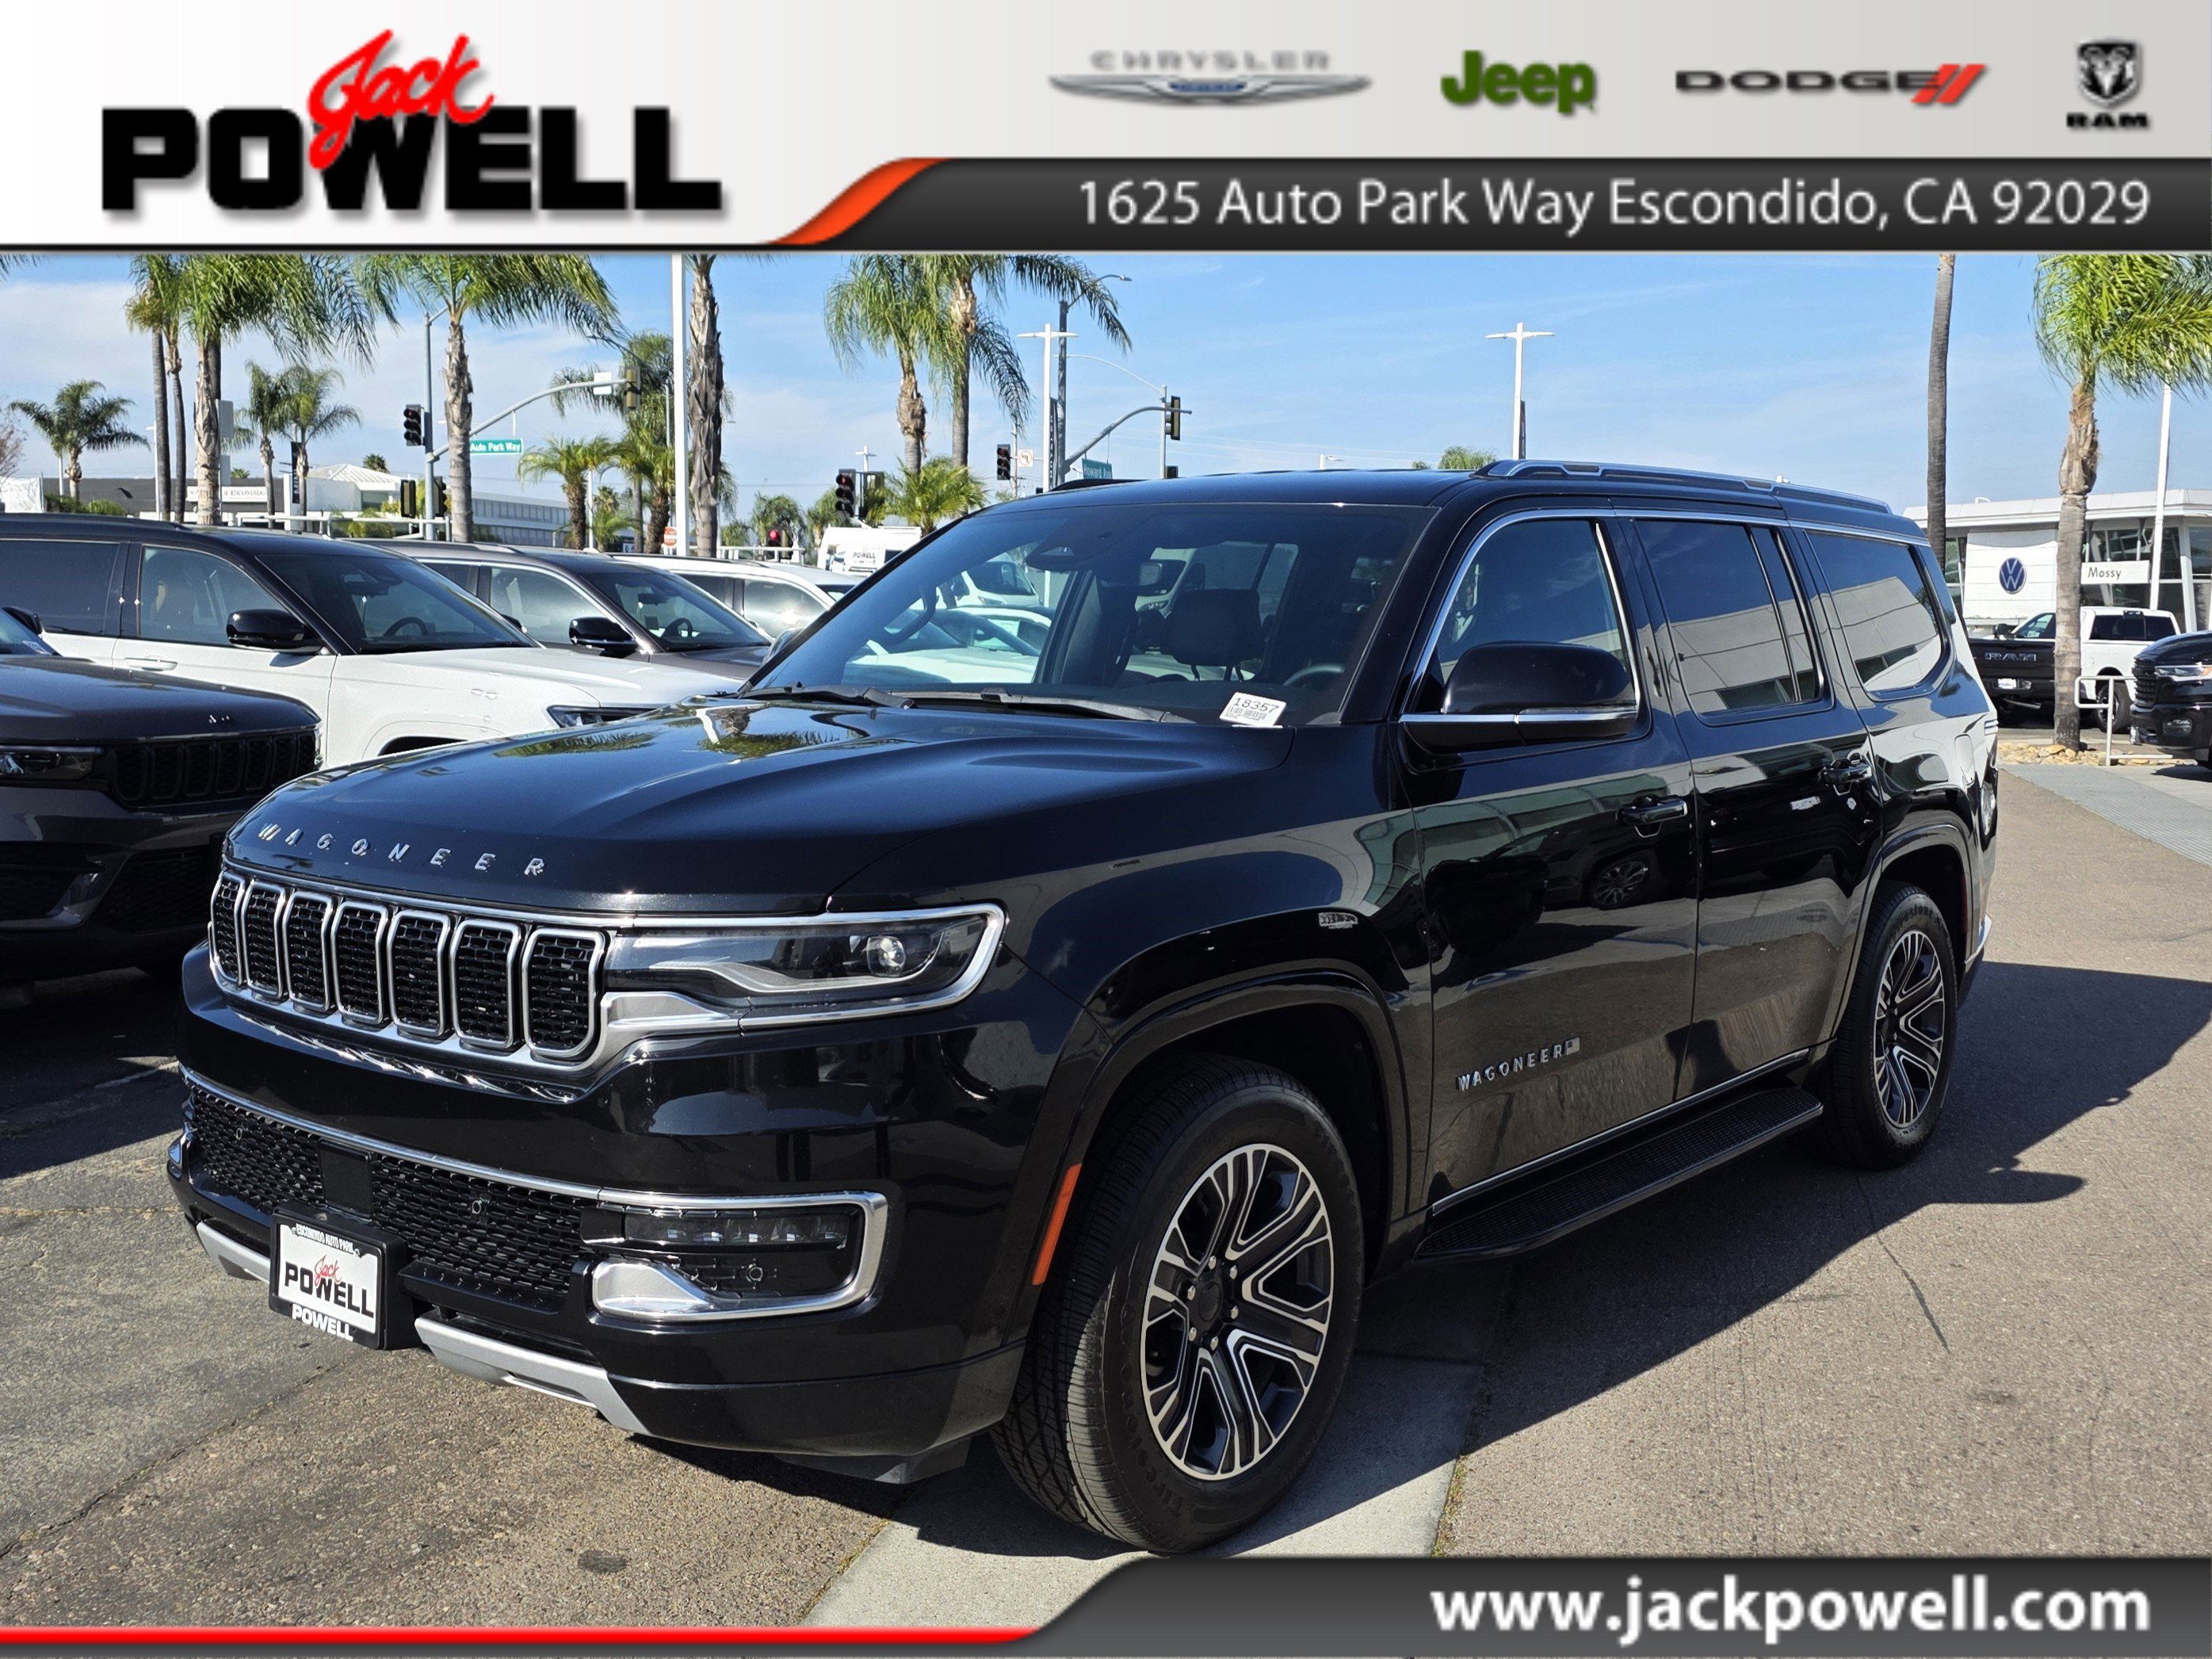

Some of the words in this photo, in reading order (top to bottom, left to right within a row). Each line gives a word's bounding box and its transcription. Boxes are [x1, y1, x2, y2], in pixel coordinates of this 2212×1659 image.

[488, 442, 504, 451] Park
[506, 442, 520, 452] Way
[2088, 567, 2122, 580] Mossy
[1985, 652, 2037, 662] RAM
[1233, 698, 1280, 713] 18357
[258, 822, 547, 877] WAGONEER
[1457, 1043, 1562, 1091] WAGONEER
[296, 1223, 325, 1244] ESCONDIDO
[325, 1233, 339, 1248] AUTO
[339, 1238, 354, 1254] PARK
[314, 1254, 342, 1286] Jack
[284, 1261, 374, 1319] POWELL
[292, 1303, 353, 1342] POWELL
